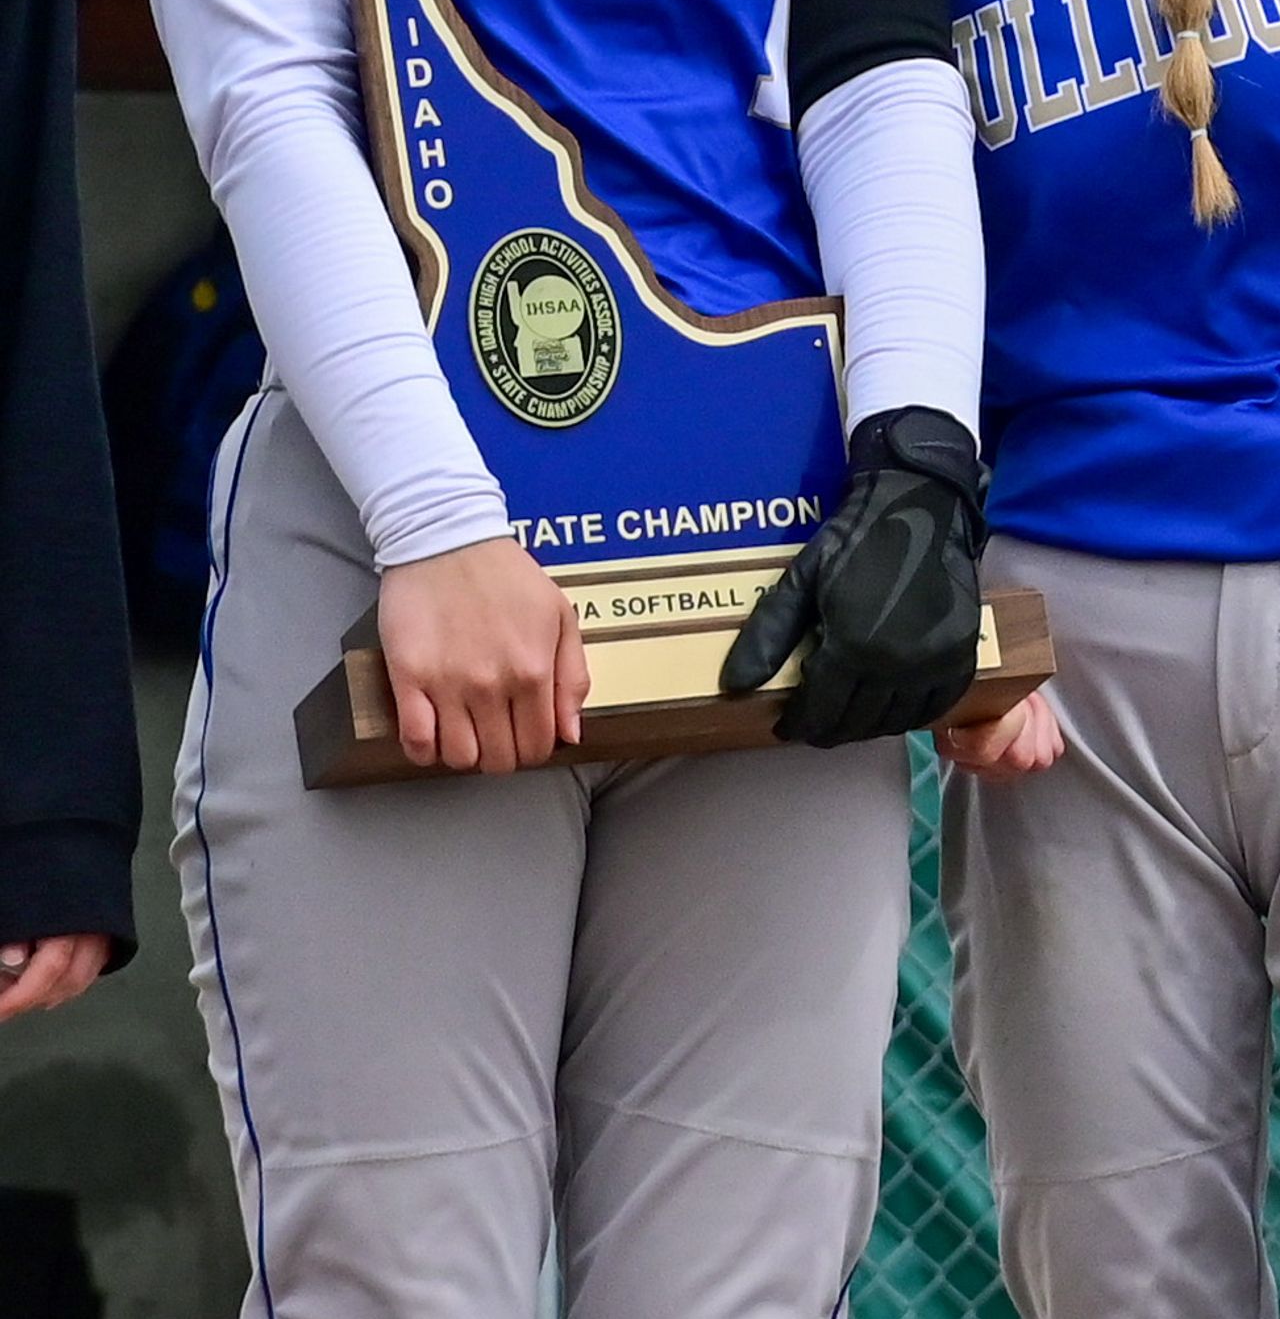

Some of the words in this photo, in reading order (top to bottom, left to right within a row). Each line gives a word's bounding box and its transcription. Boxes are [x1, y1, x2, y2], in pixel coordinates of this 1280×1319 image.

[406, 17, 454, 210] IDAHO
[489, 236, 538, 275] SCHOOL
[539, 237, 601, 293] ACTIVITIES
[478, 272, 501, 308] HIGH
[525, 299, 582, 316] IHSAA
[477, 309, 498, 352] IDAHO
[492, 364, 527, 403] STATE
[526, 355, 612, 419] CHAMPIONSHIP
[509, 513, 606, 549] TATE
[616, 494, 822, 541] CHAMPION
[611, 588, 745, 617] SOFTBALL
